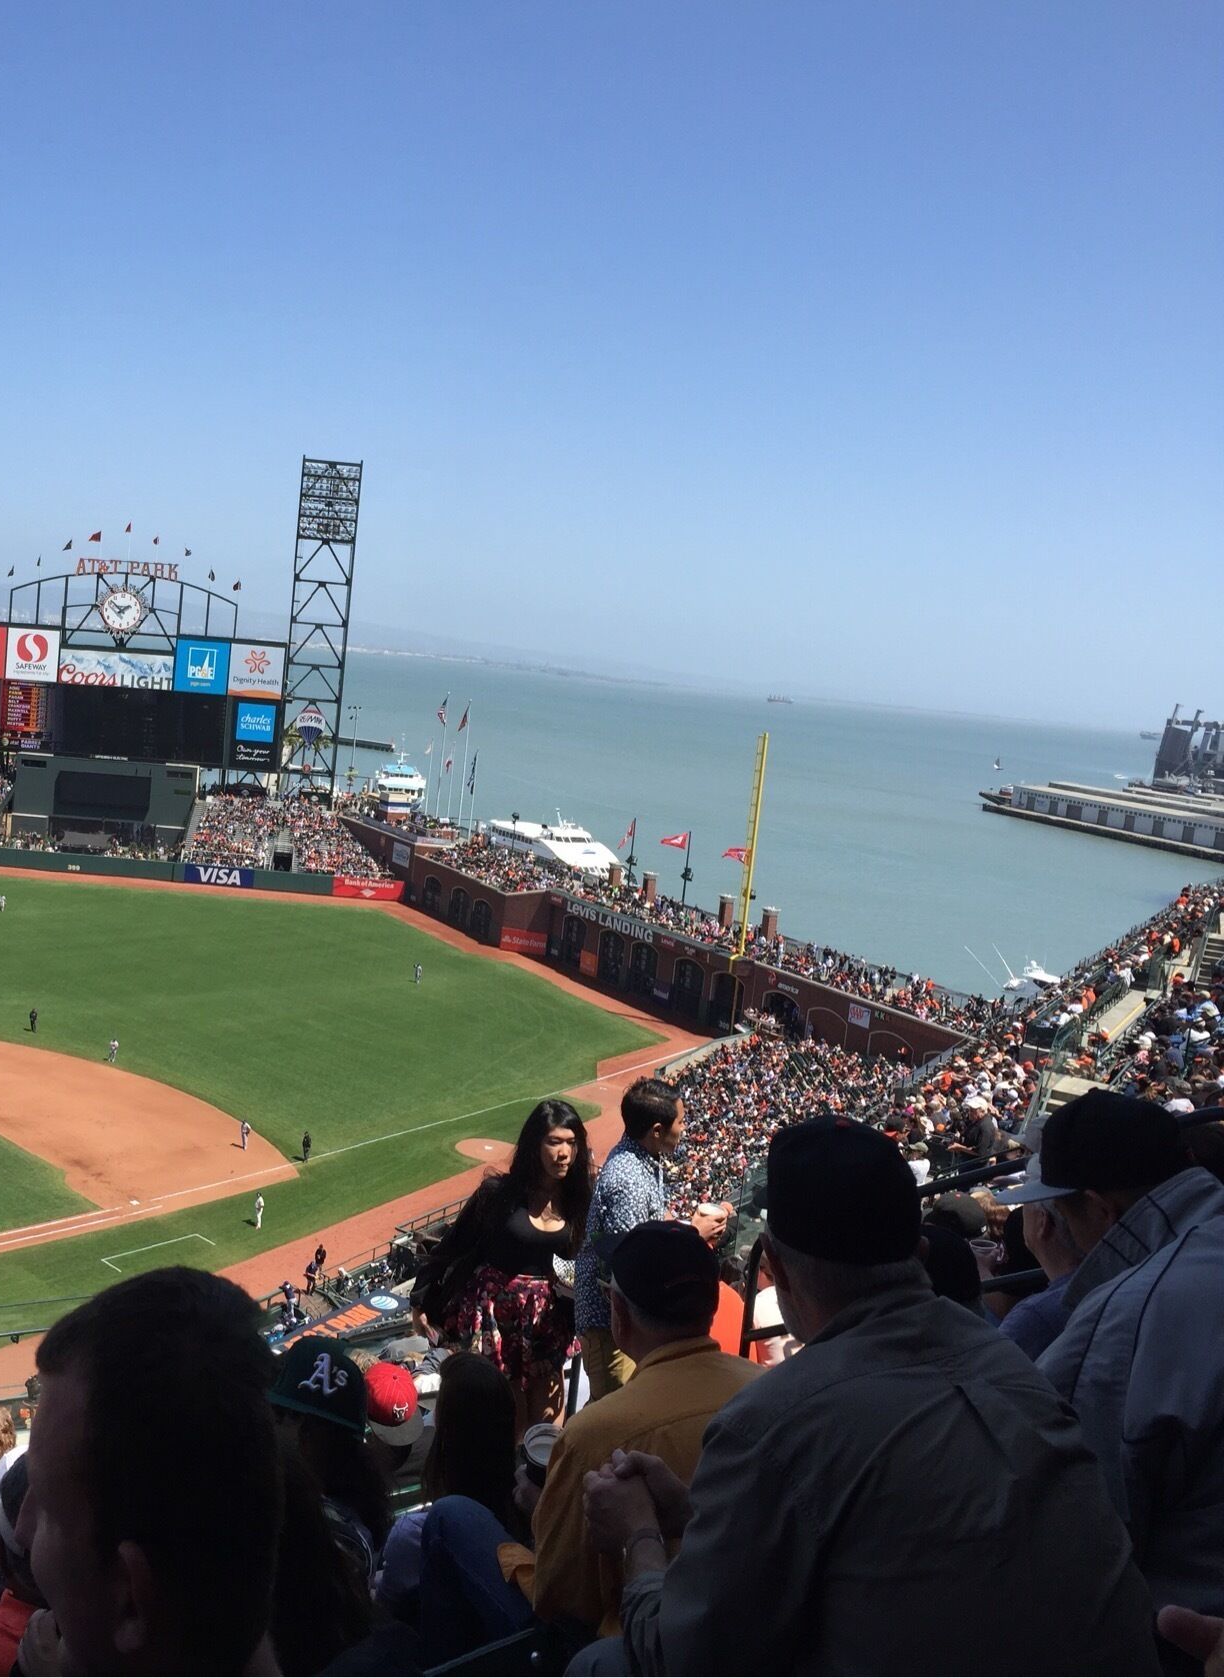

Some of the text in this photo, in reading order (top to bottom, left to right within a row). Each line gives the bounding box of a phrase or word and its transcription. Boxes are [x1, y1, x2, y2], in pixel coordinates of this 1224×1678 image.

[75, 558, 179, 582] AT&T PARK
[15, 662, 47, 671] SAFEWAY
[189, 665, 214, 678] PG&E
[58, 663, 173, 692] Coors LIGHT
[232, 676, 279, 686] Dignity Health
[240, 713, 271, 725] charles
[299, 715, 323, 725] RE/MAX
[240, 723, 271, 732] SCHWAB
[196, 866, 241, 886] VISA
[344, 879, 360, 887] Bank
[368, 880, 394, 889] America
[598, 912, 654, 943] LANDING
[512, 936, 546, 949] State Farm
[326, 1303, 383, 1331] PARK
[297, 1352, 350, 1396] A's
